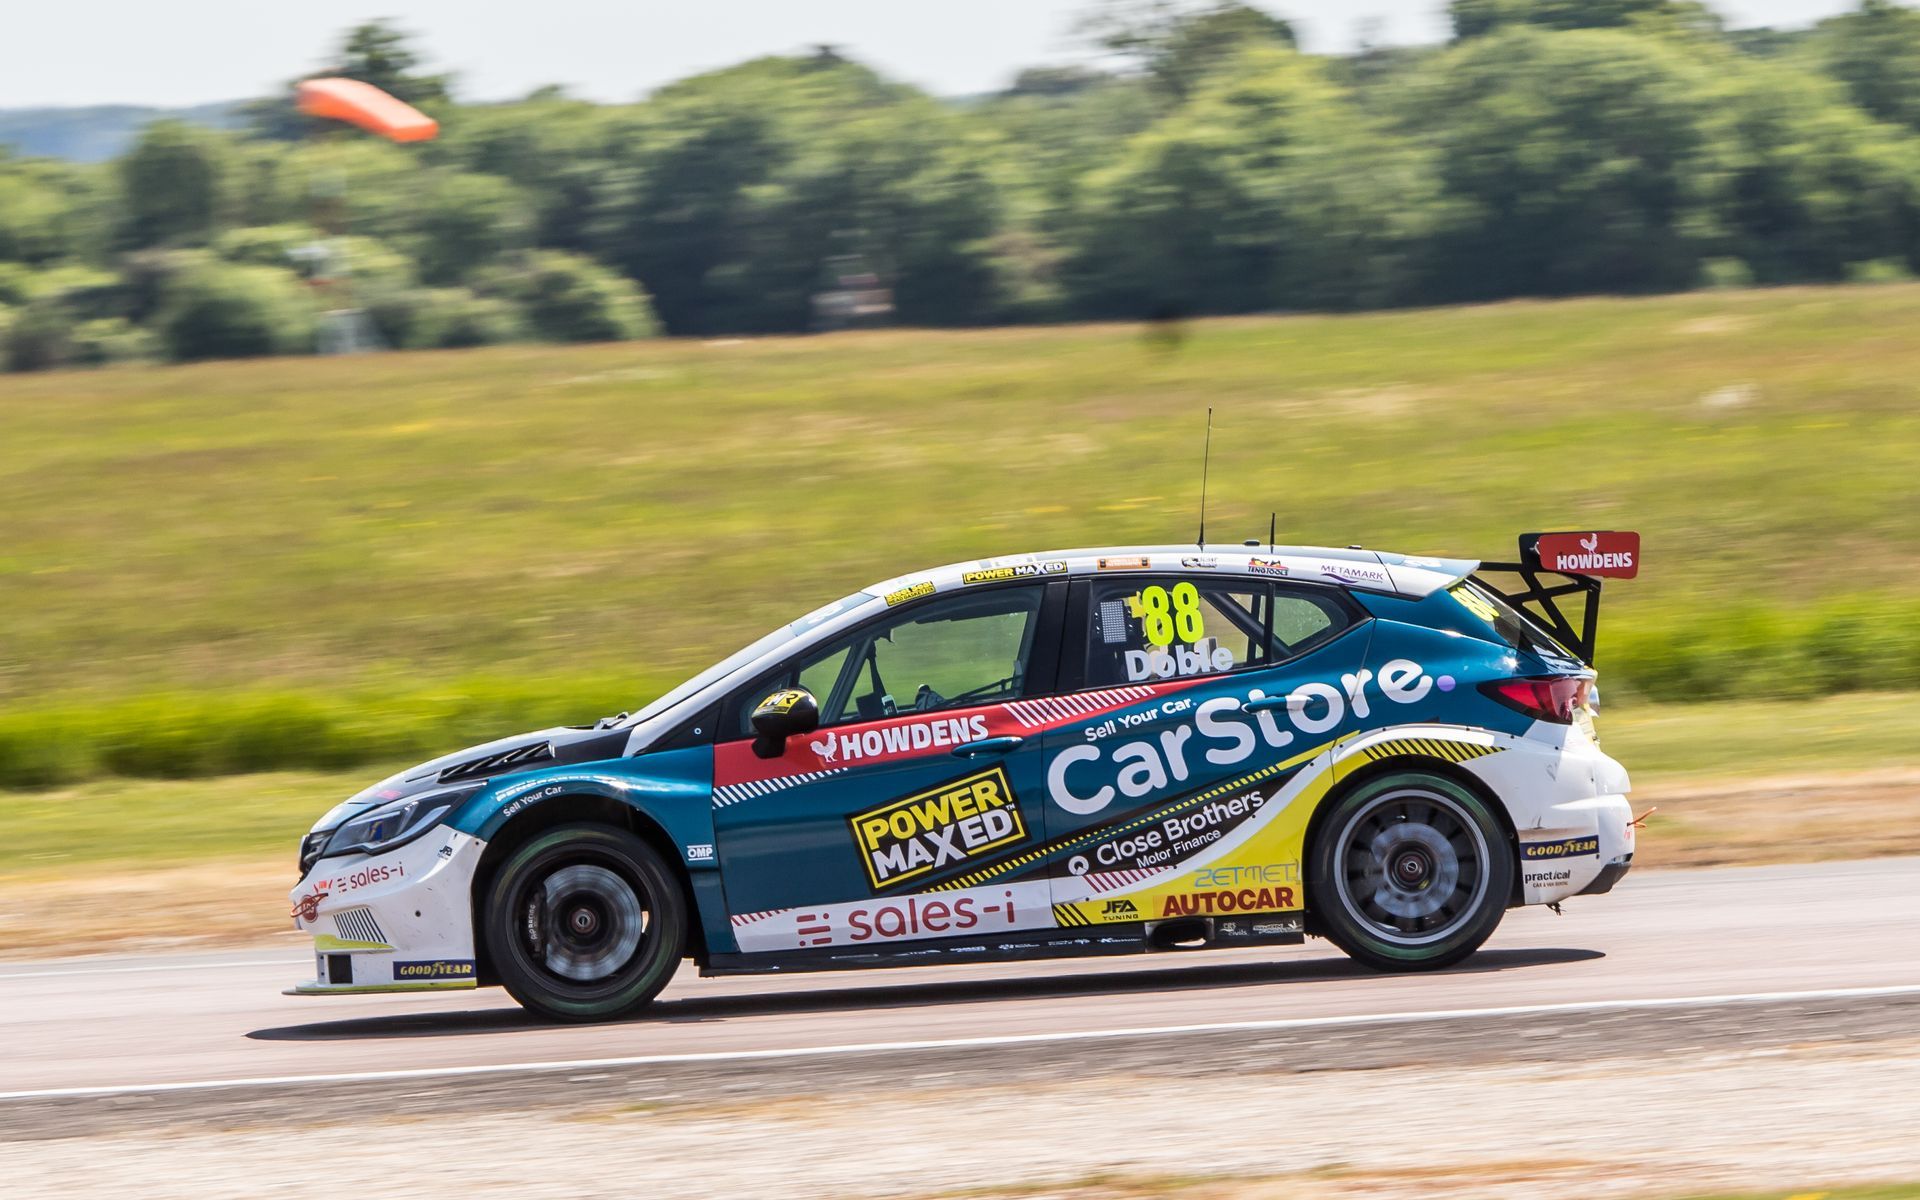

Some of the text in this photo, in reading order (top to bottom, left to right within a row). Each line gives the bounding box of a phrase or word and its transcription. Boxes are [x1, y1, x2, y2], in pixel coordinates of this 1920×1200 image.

[966, 561, 1064, 582] POWER MAXED
[1321, 564, 1384, 580] METAMARK
[1556, 551, 1633, 571] HOWDENS
[1142, 582, 1204, 647] 88
[1125, 643, 1234, 682] Doble
[842, 715, 989, 761] HOWDENS
[1084, 720, 1117, 742] Sell
[1118, 708, 1159, 729] Your
[503, 801, 522, 818] Sell
[521, 790, 544, 806] Your
[861, 780, 1005, 850] POWER
[1097, 790, 1265, 866] Close Brothers
[687, 846, 713, 858] OMP
[871, 808, 1015, 881] MAXED
[1136, 829, 1221, 869] Motor Finance
[350, 861, 404, 890] sales-i
[1525, 869, 1572, 884] practical
[849, 890, 1015, 942] sales-i
[1101, 899, 1139, 914] JFA
[1162, 887, 1294, 917] AUTOCAR
